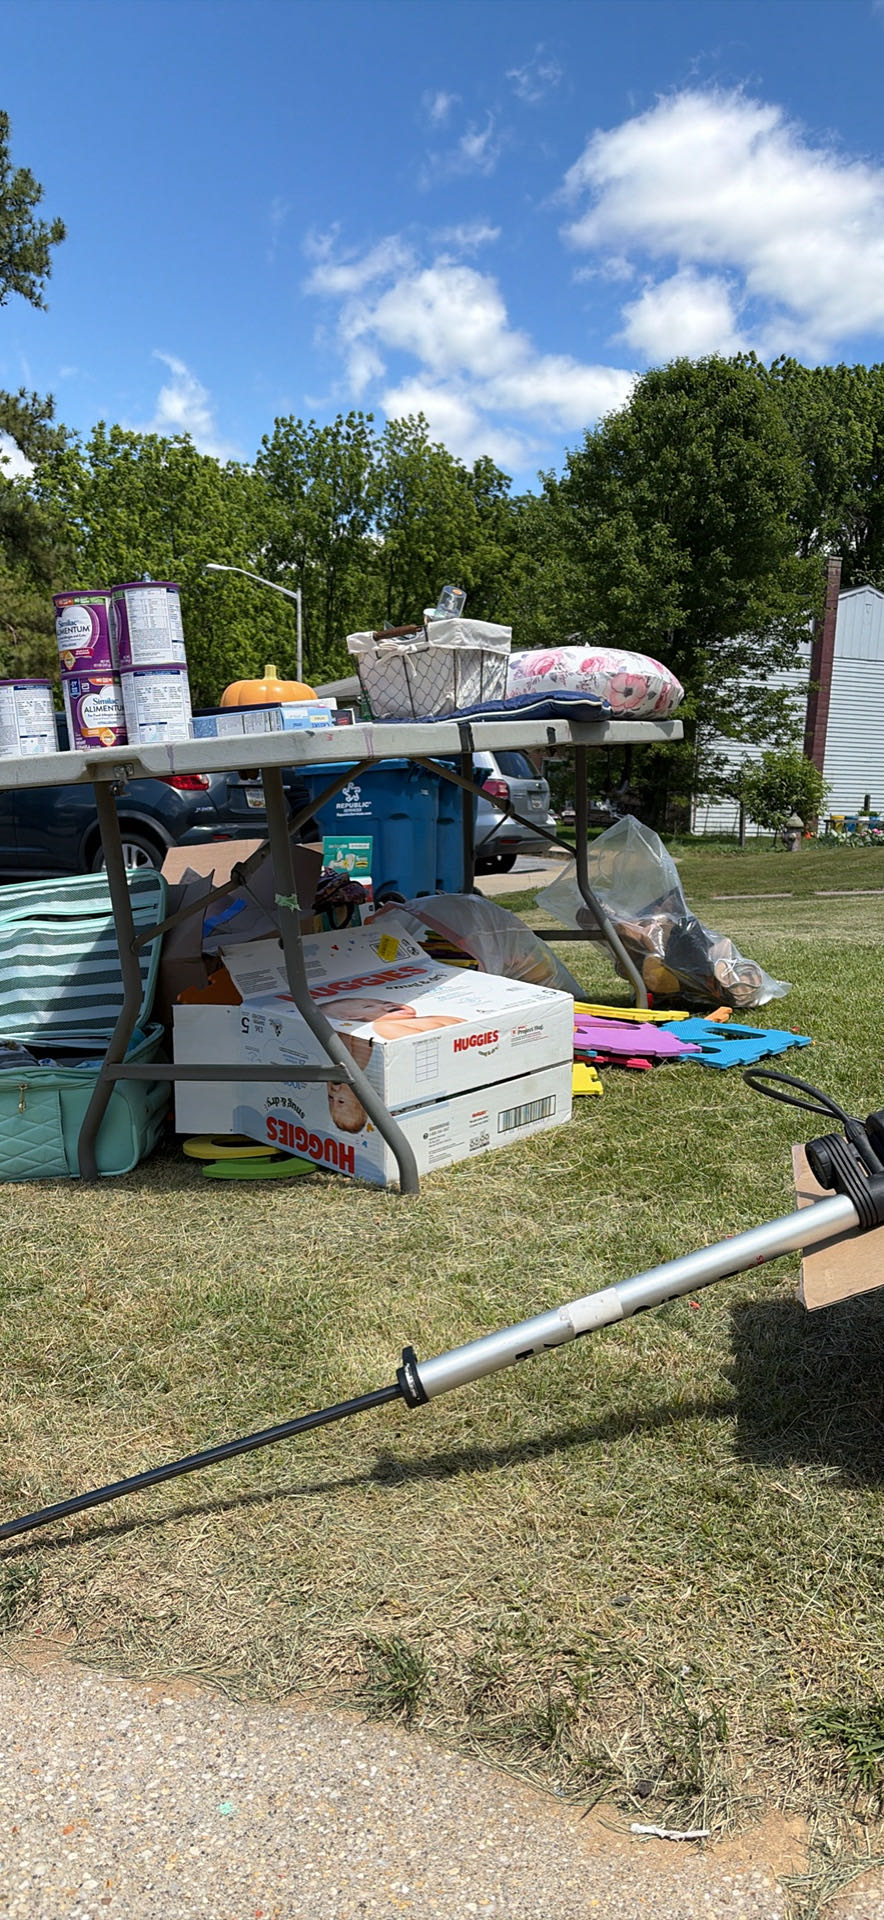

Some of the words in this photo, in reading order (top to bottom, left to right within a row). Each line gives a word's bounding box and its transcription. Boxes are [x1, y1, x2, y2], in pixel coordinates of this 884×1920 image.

[92, 697, 119, 706] Similac
[336, 801, 370, 809] REPUBLIC
[274, 966, 428, 1002] UGGIES
[241, 1016, 250, 1034] 5
[453, 1030, 499, 1053] HUGGIES
[286, 1098, 306, 1120] snug
[265, 1116, 355, 1175] HUGGIES
